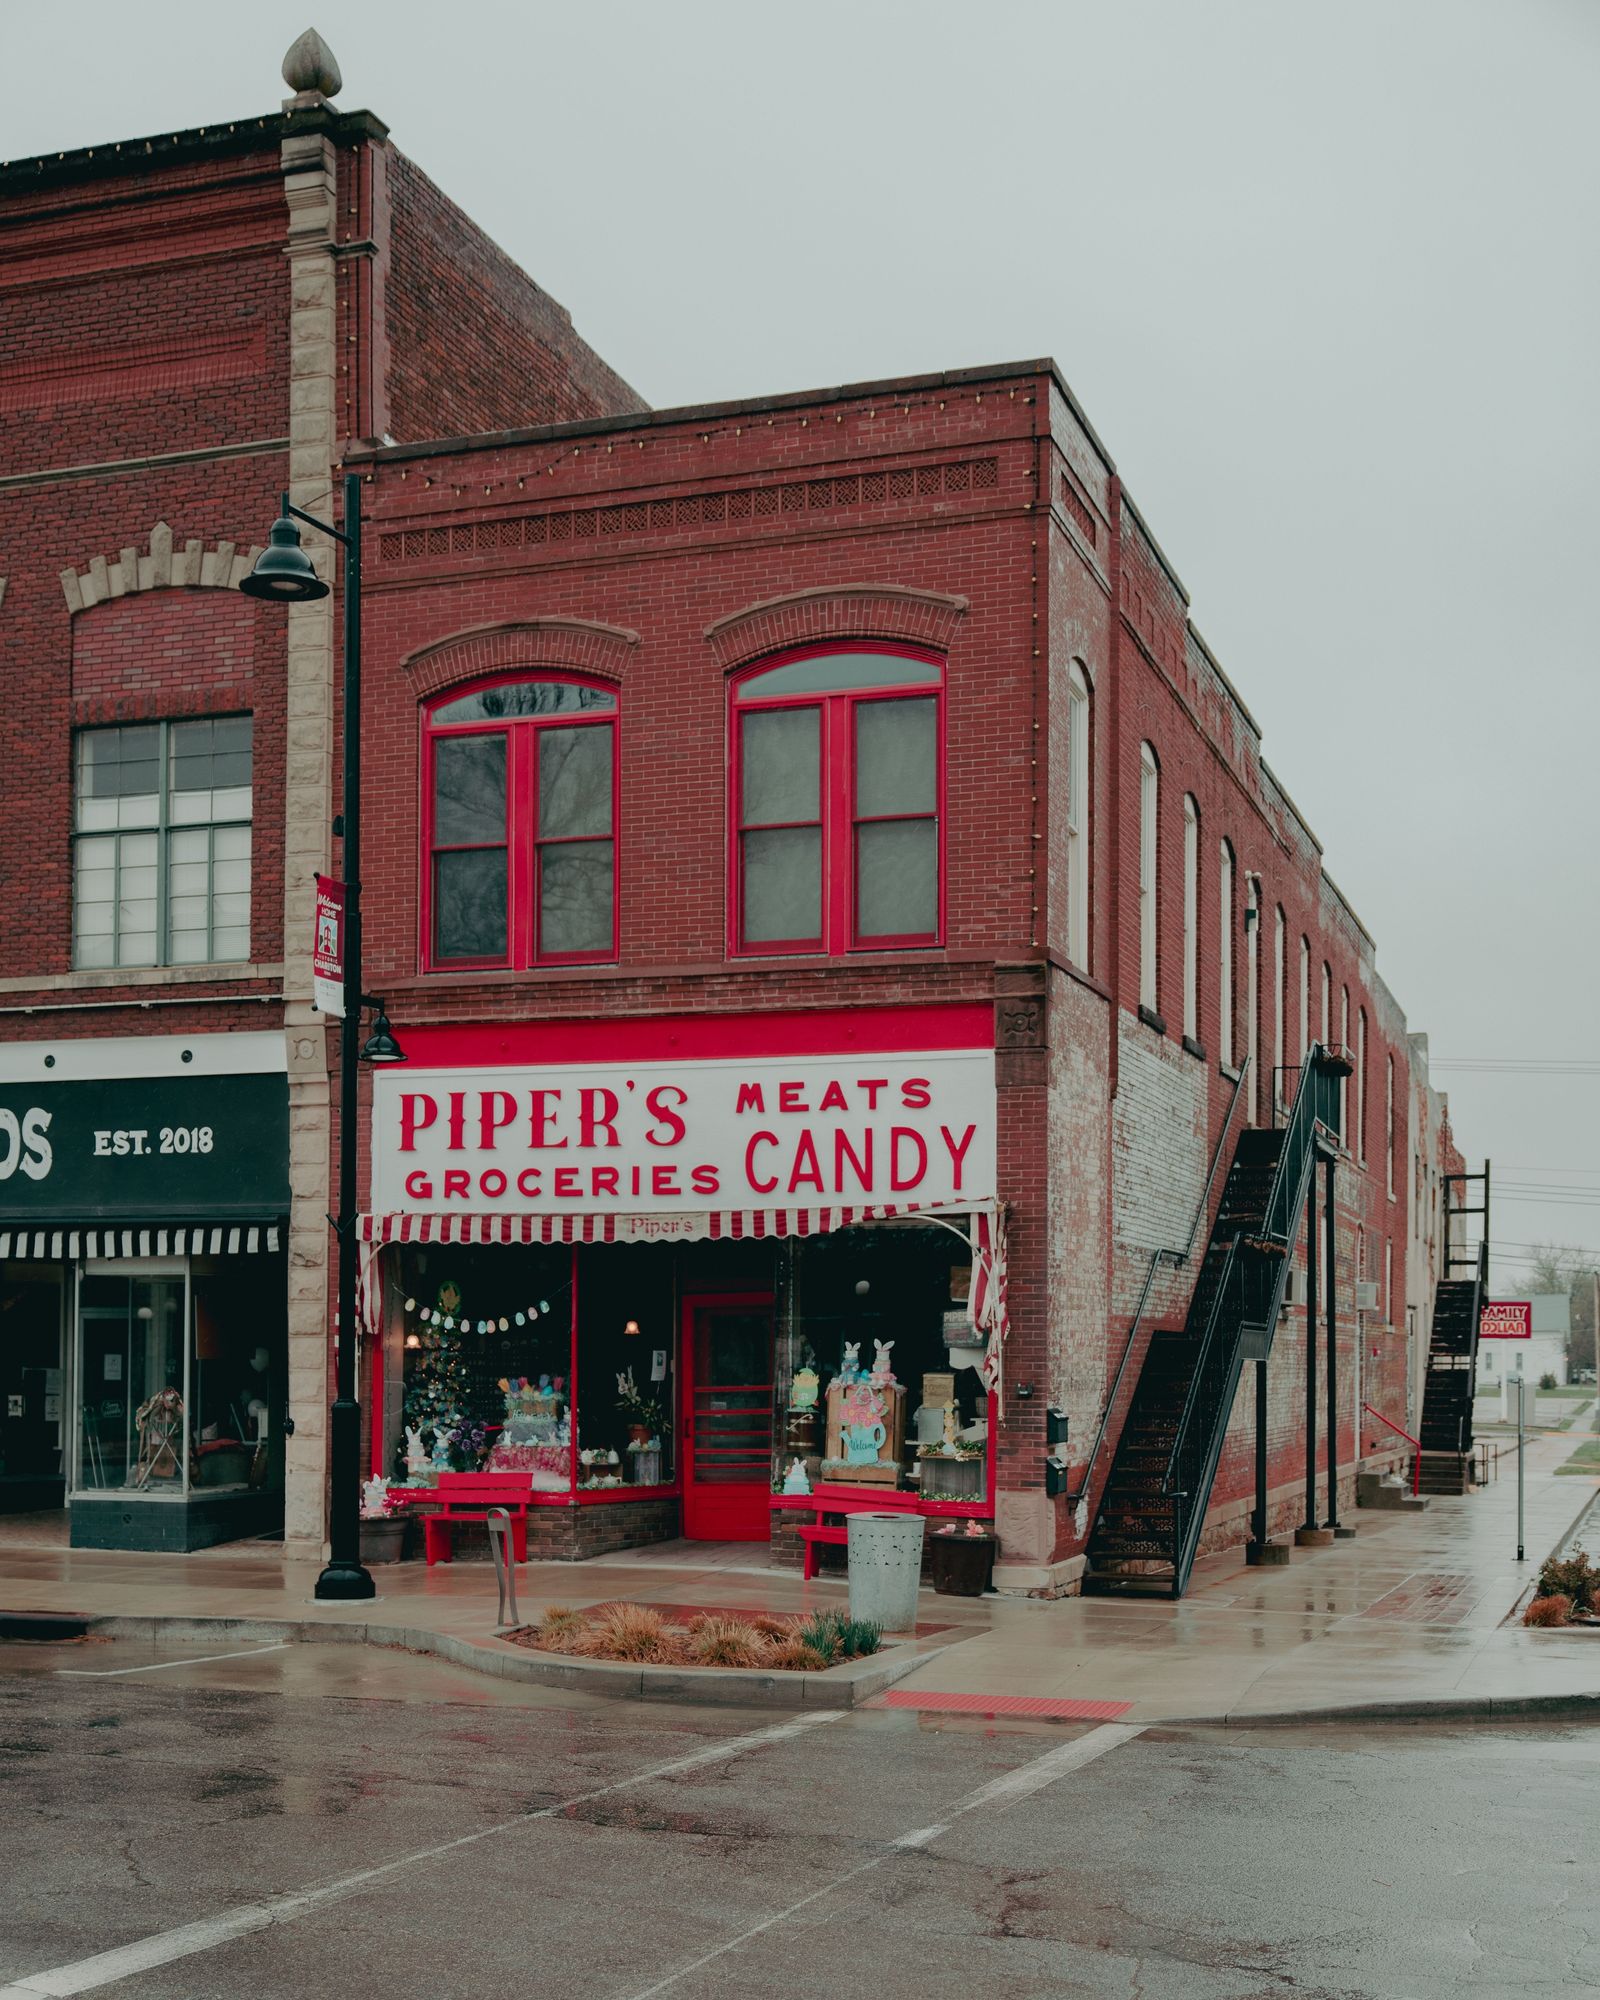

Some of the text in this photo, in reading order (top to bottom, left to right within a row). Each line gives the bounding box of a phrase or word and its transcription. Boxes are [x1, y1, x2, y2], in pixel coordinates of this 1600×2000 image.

[735, 1077, 932, 1114] MEATS
[399, 1080, 688, 1152] PIPER'S
[93, 1127, 214, 1156] EST. 2018
[744, 1123, 977, 1194] CANDY
[404, 1164, 721, 1200] GROCERIES
[631, 1217, 693, 1237] Piper's
[1480, 1320, 1526, 1335] DOLLAR
[1481, 1305, 1528, 1320] FAMILY
